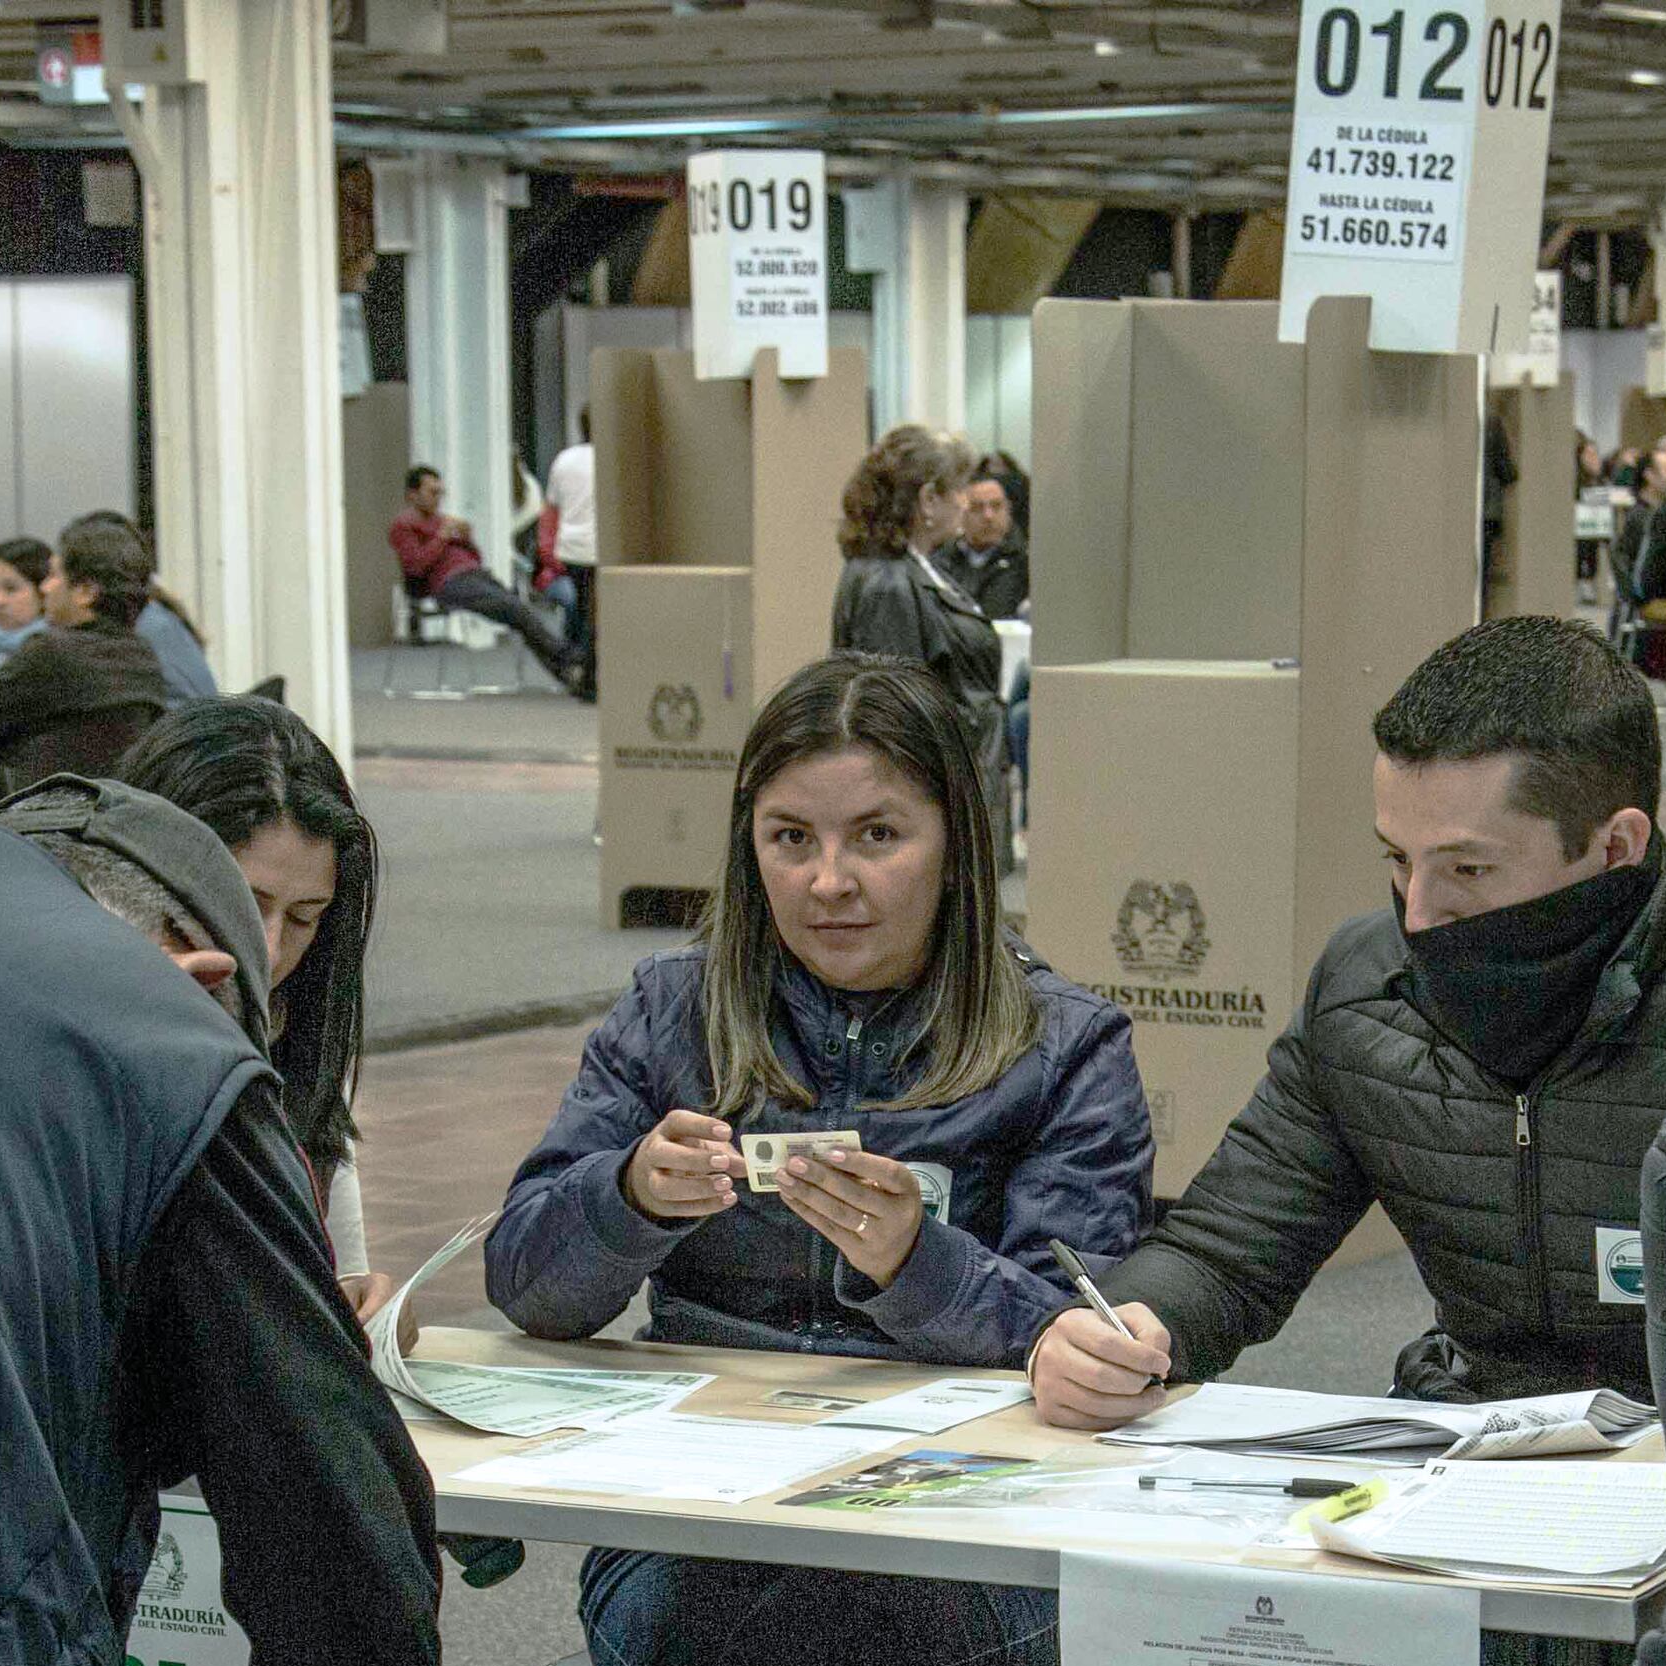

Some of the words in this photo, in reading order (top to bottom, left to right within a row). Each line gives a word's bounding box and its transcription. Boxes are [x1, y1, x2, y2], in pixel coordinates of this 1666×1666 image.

[1315, 7, 1469, 101] 012
[1486, 17, 1551, 109] 012
[1337, 126, 1353, 141] DE
[1358, 127, 1373, 142] LA
[1377, 127, 1428, 145] CÉDULA
[1307, 147, 1455, 181] 41.739.122
[728, 178, 811, 231] 019
[1319, 193, 1360, 209] HASTA
[1364, 195, 1379, 210] LA
[1383, 196, 1434, 214] CÉDULA
[1301, 215, 1447, 249] 51.660.574
[1090, 984, 1266, 1014] GISTRADURÍA
[1166, 1011, 1223, 1026] ESTADO
[1227, 1014, 1264, 1028] CIVIL
[134, 1604, 226, 1626] TRADURÍA
[138, 1620, 157, 1629] DEL
[160, 1622, 198, 1634] ESTADO
[201, 1627, 227, 1637] CIVIL
